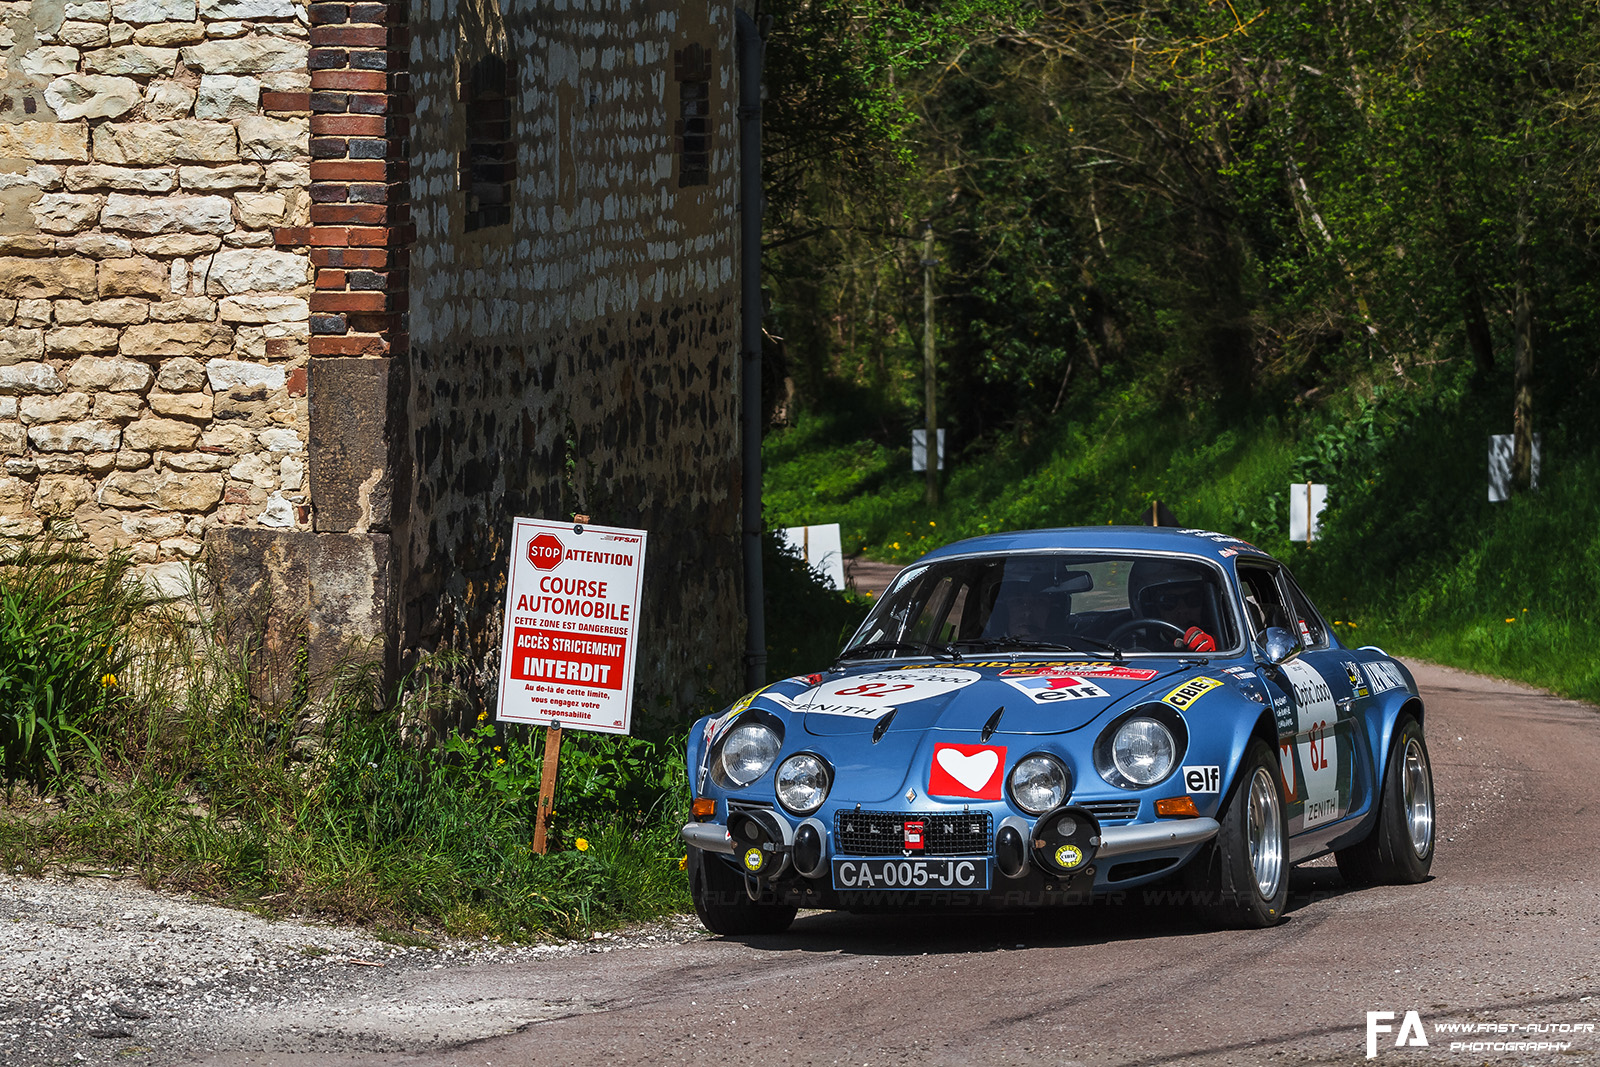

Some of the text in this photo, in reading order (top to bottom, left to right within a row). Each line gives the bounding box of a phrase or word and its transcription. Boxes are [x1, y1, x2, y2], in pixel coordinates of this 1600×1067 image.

[531, 546, 560, 558] STOP
[565, 549, 633, 567] ATTENTION
[540, 576, 608, 599] COURSE
[517, 594, 630, 622] AUTOMOBILE
[515, 616, 629, 635] CETTE ZONE EST DANGEREUSE
[517, 632, 622, 658] ACCÈS STRICTEMENT
[523, 657, 611, 684] INTERDIT
[525, 683, 534, 691] Au
[556, 685, 564, 694] de
[566, 687, 585, 697] cette
[587, 690, 610, 700] limite,
[834, 683, 915, 697] 82
[1034, 685, 1101, 700] elf
[531, 696, 600, 709] vous engagez votre
[778, 699, 877, 716] ZENITH
[540, 707, 592, 720] responsabilité
[1308, 720, 1328, 772] 82
[1186, 768, 1219, 791] elf
[1308, 798, 1336, 821] ZENITH
[846, 822, 980, 834] ALPNE
[840, 862, 975, 886] CA-005-JC
